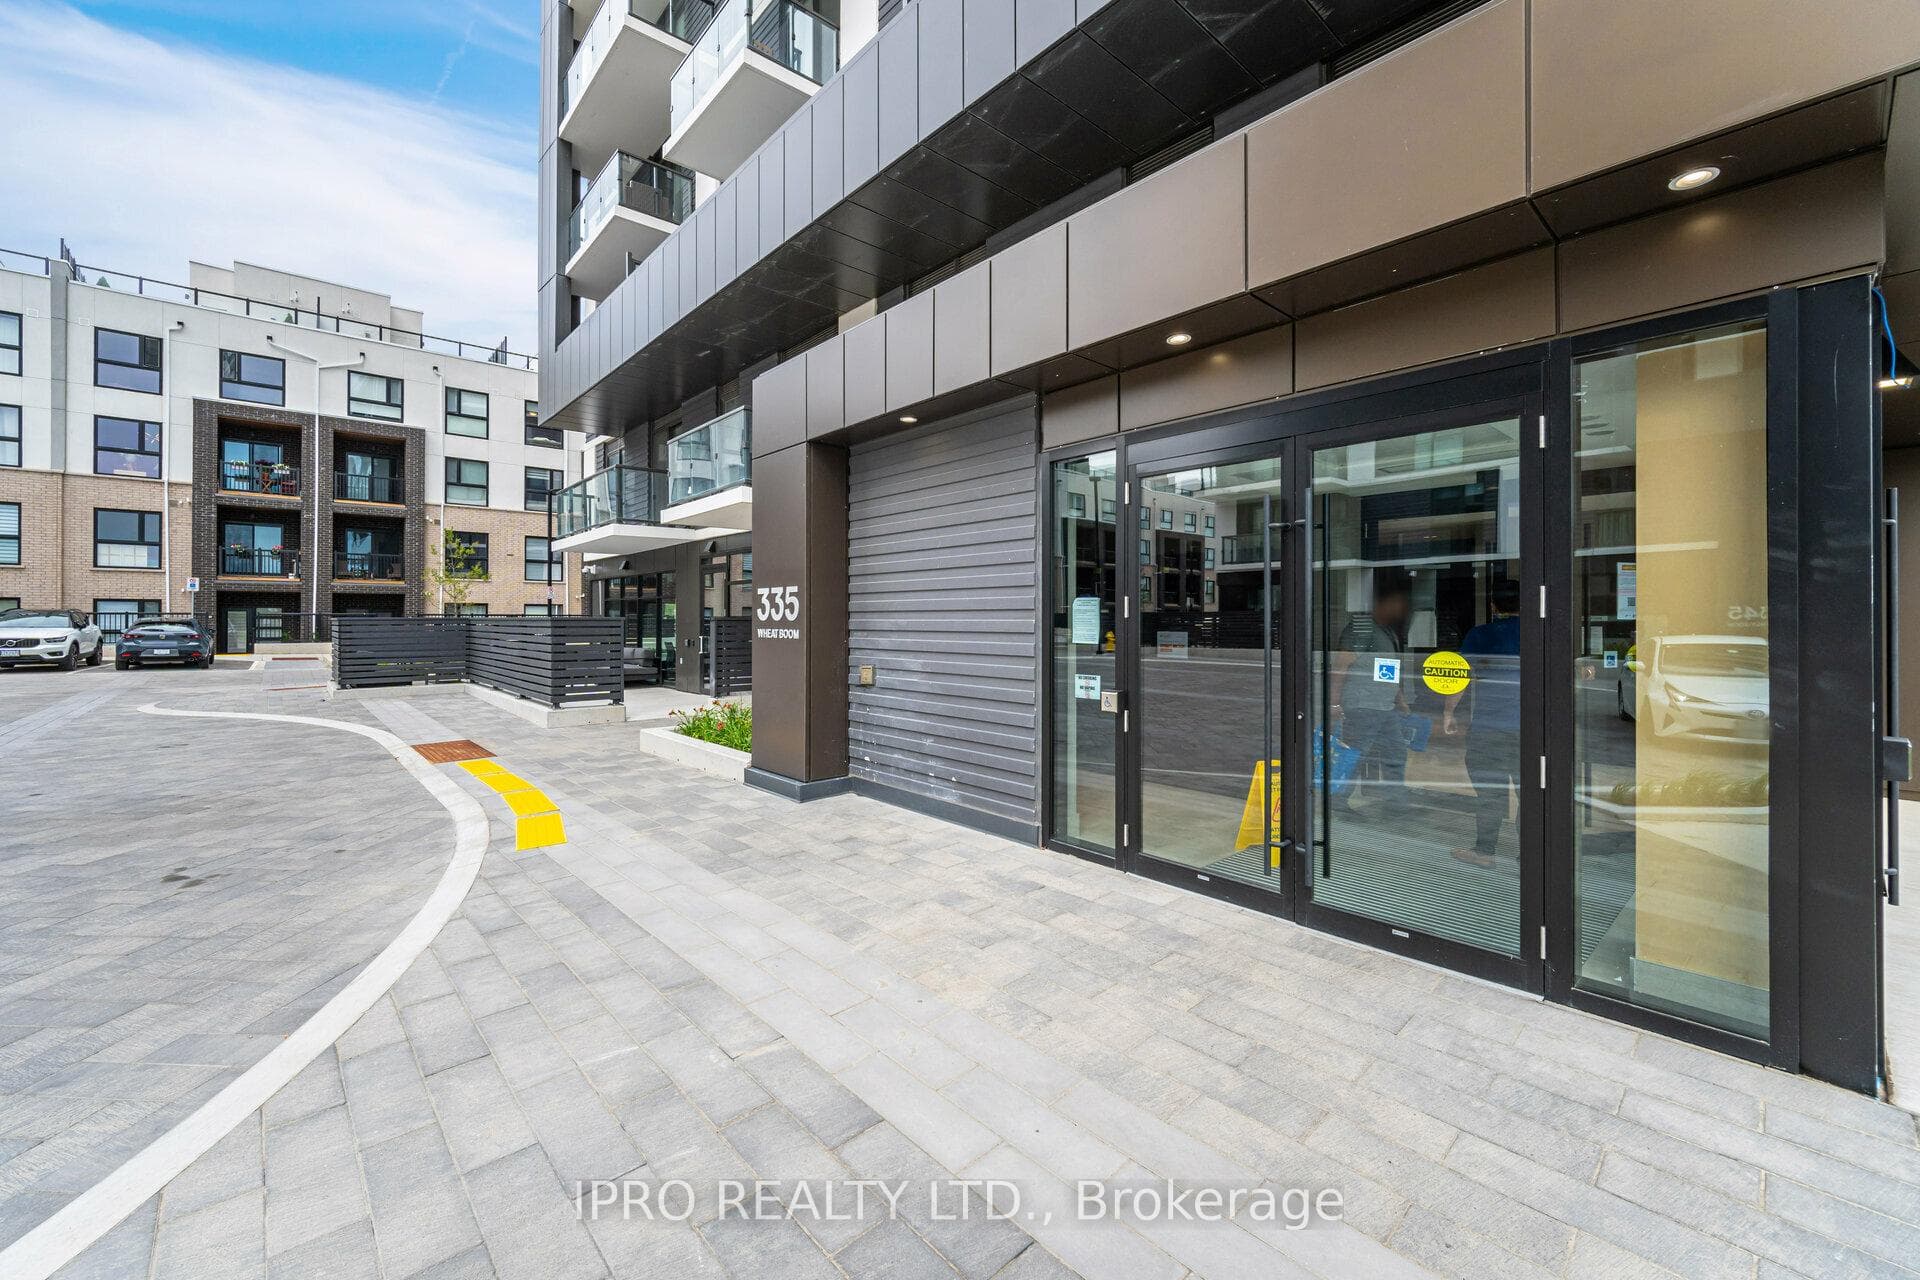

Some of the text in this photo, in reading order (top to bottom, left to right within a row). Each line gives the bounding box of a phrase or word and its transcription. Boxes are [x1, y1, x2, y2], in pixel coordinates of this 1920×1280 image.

[757, 586, 799, 621] 335
[757, 628, 778, 638] WHEAT
[1424, 667, 1468, 677] CAUTION
